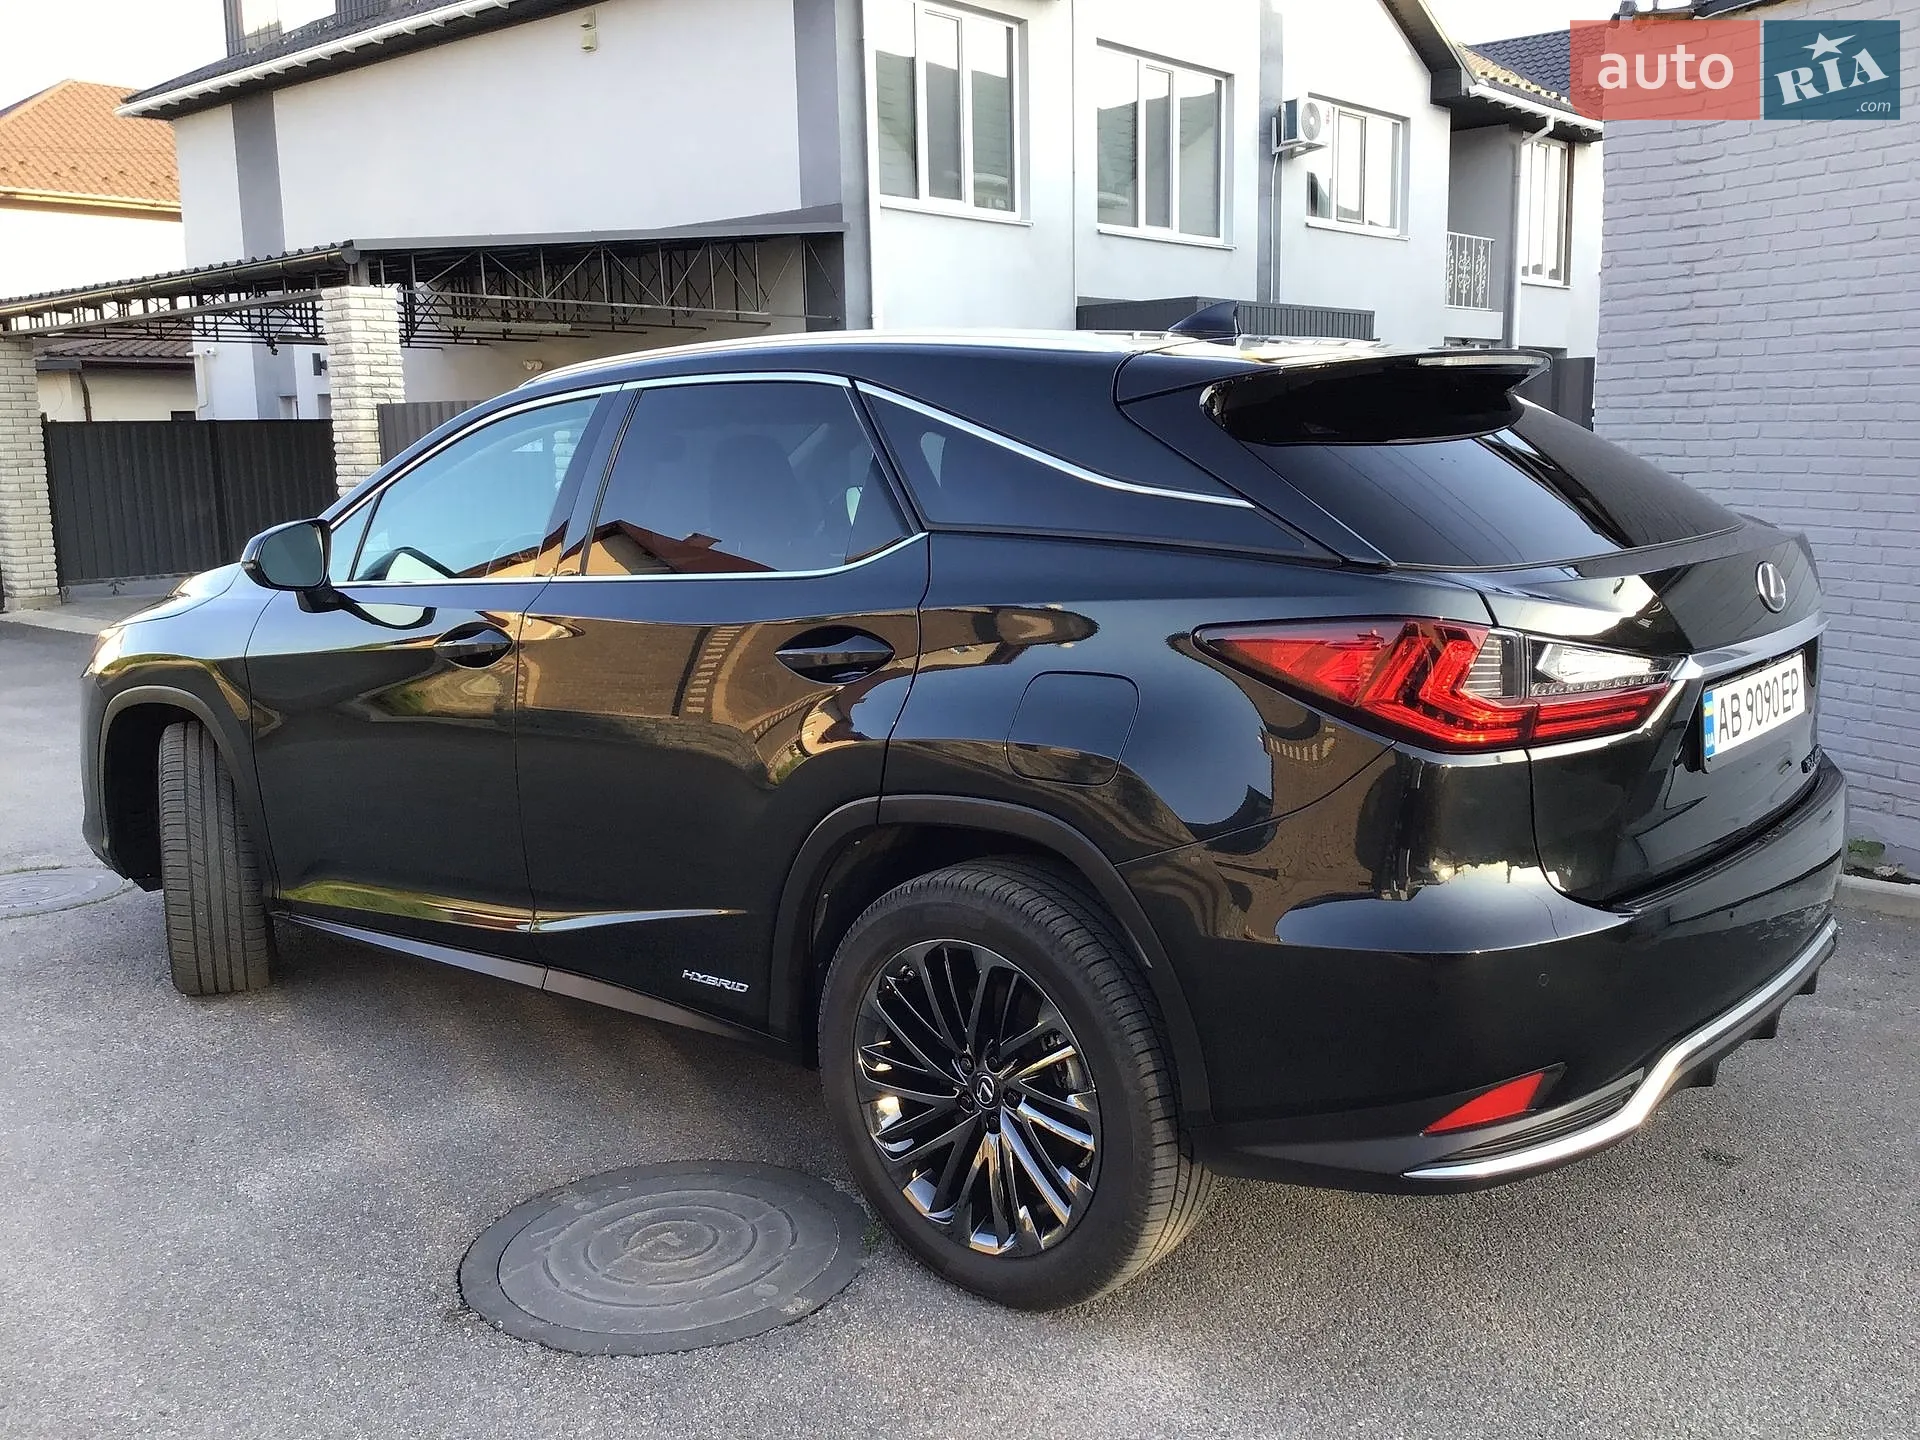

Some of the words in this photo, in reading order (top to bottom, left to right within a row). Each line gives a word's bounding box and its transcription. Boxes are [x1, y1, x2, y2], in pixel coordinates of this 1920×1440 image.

[1718, 692, 1742, 744] AB
[1745, 676, 1780, 731] 9090
[1781, 667, 1799, 714] EP
[681, 969, 749, 993] HYBRID
